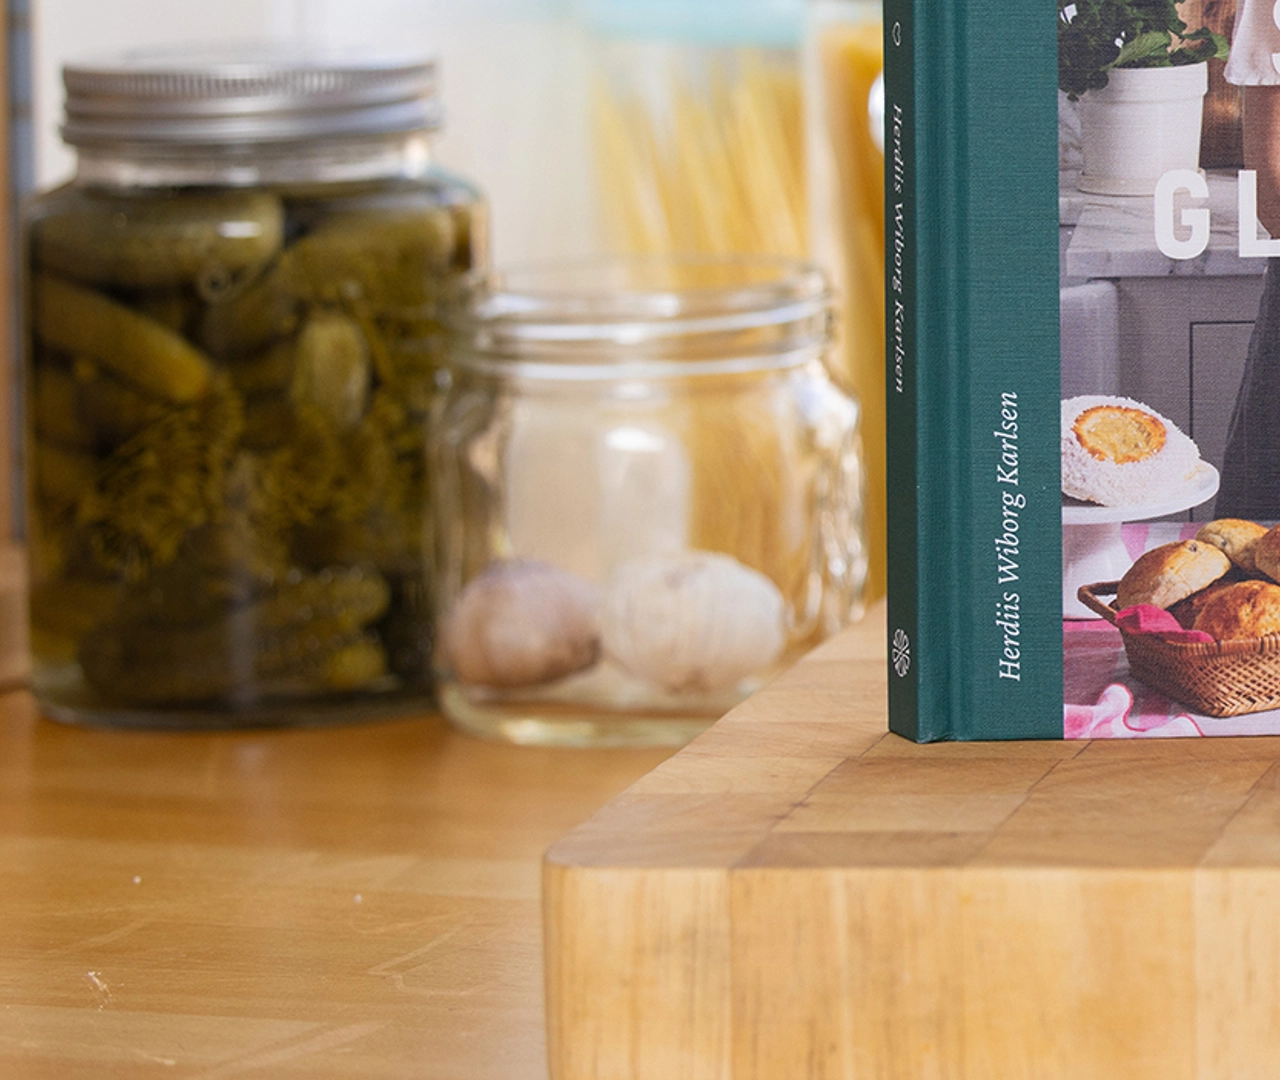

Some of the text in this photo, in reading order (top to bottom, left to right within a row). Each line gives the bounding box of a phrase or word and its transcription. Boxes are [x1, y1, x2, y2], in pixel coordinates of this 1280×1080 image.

[891, 102, 906, 394] Herdiis Wiborg Karlsen
[993, 391, 1027, 682] Herdiis Wiborg Karlsen
